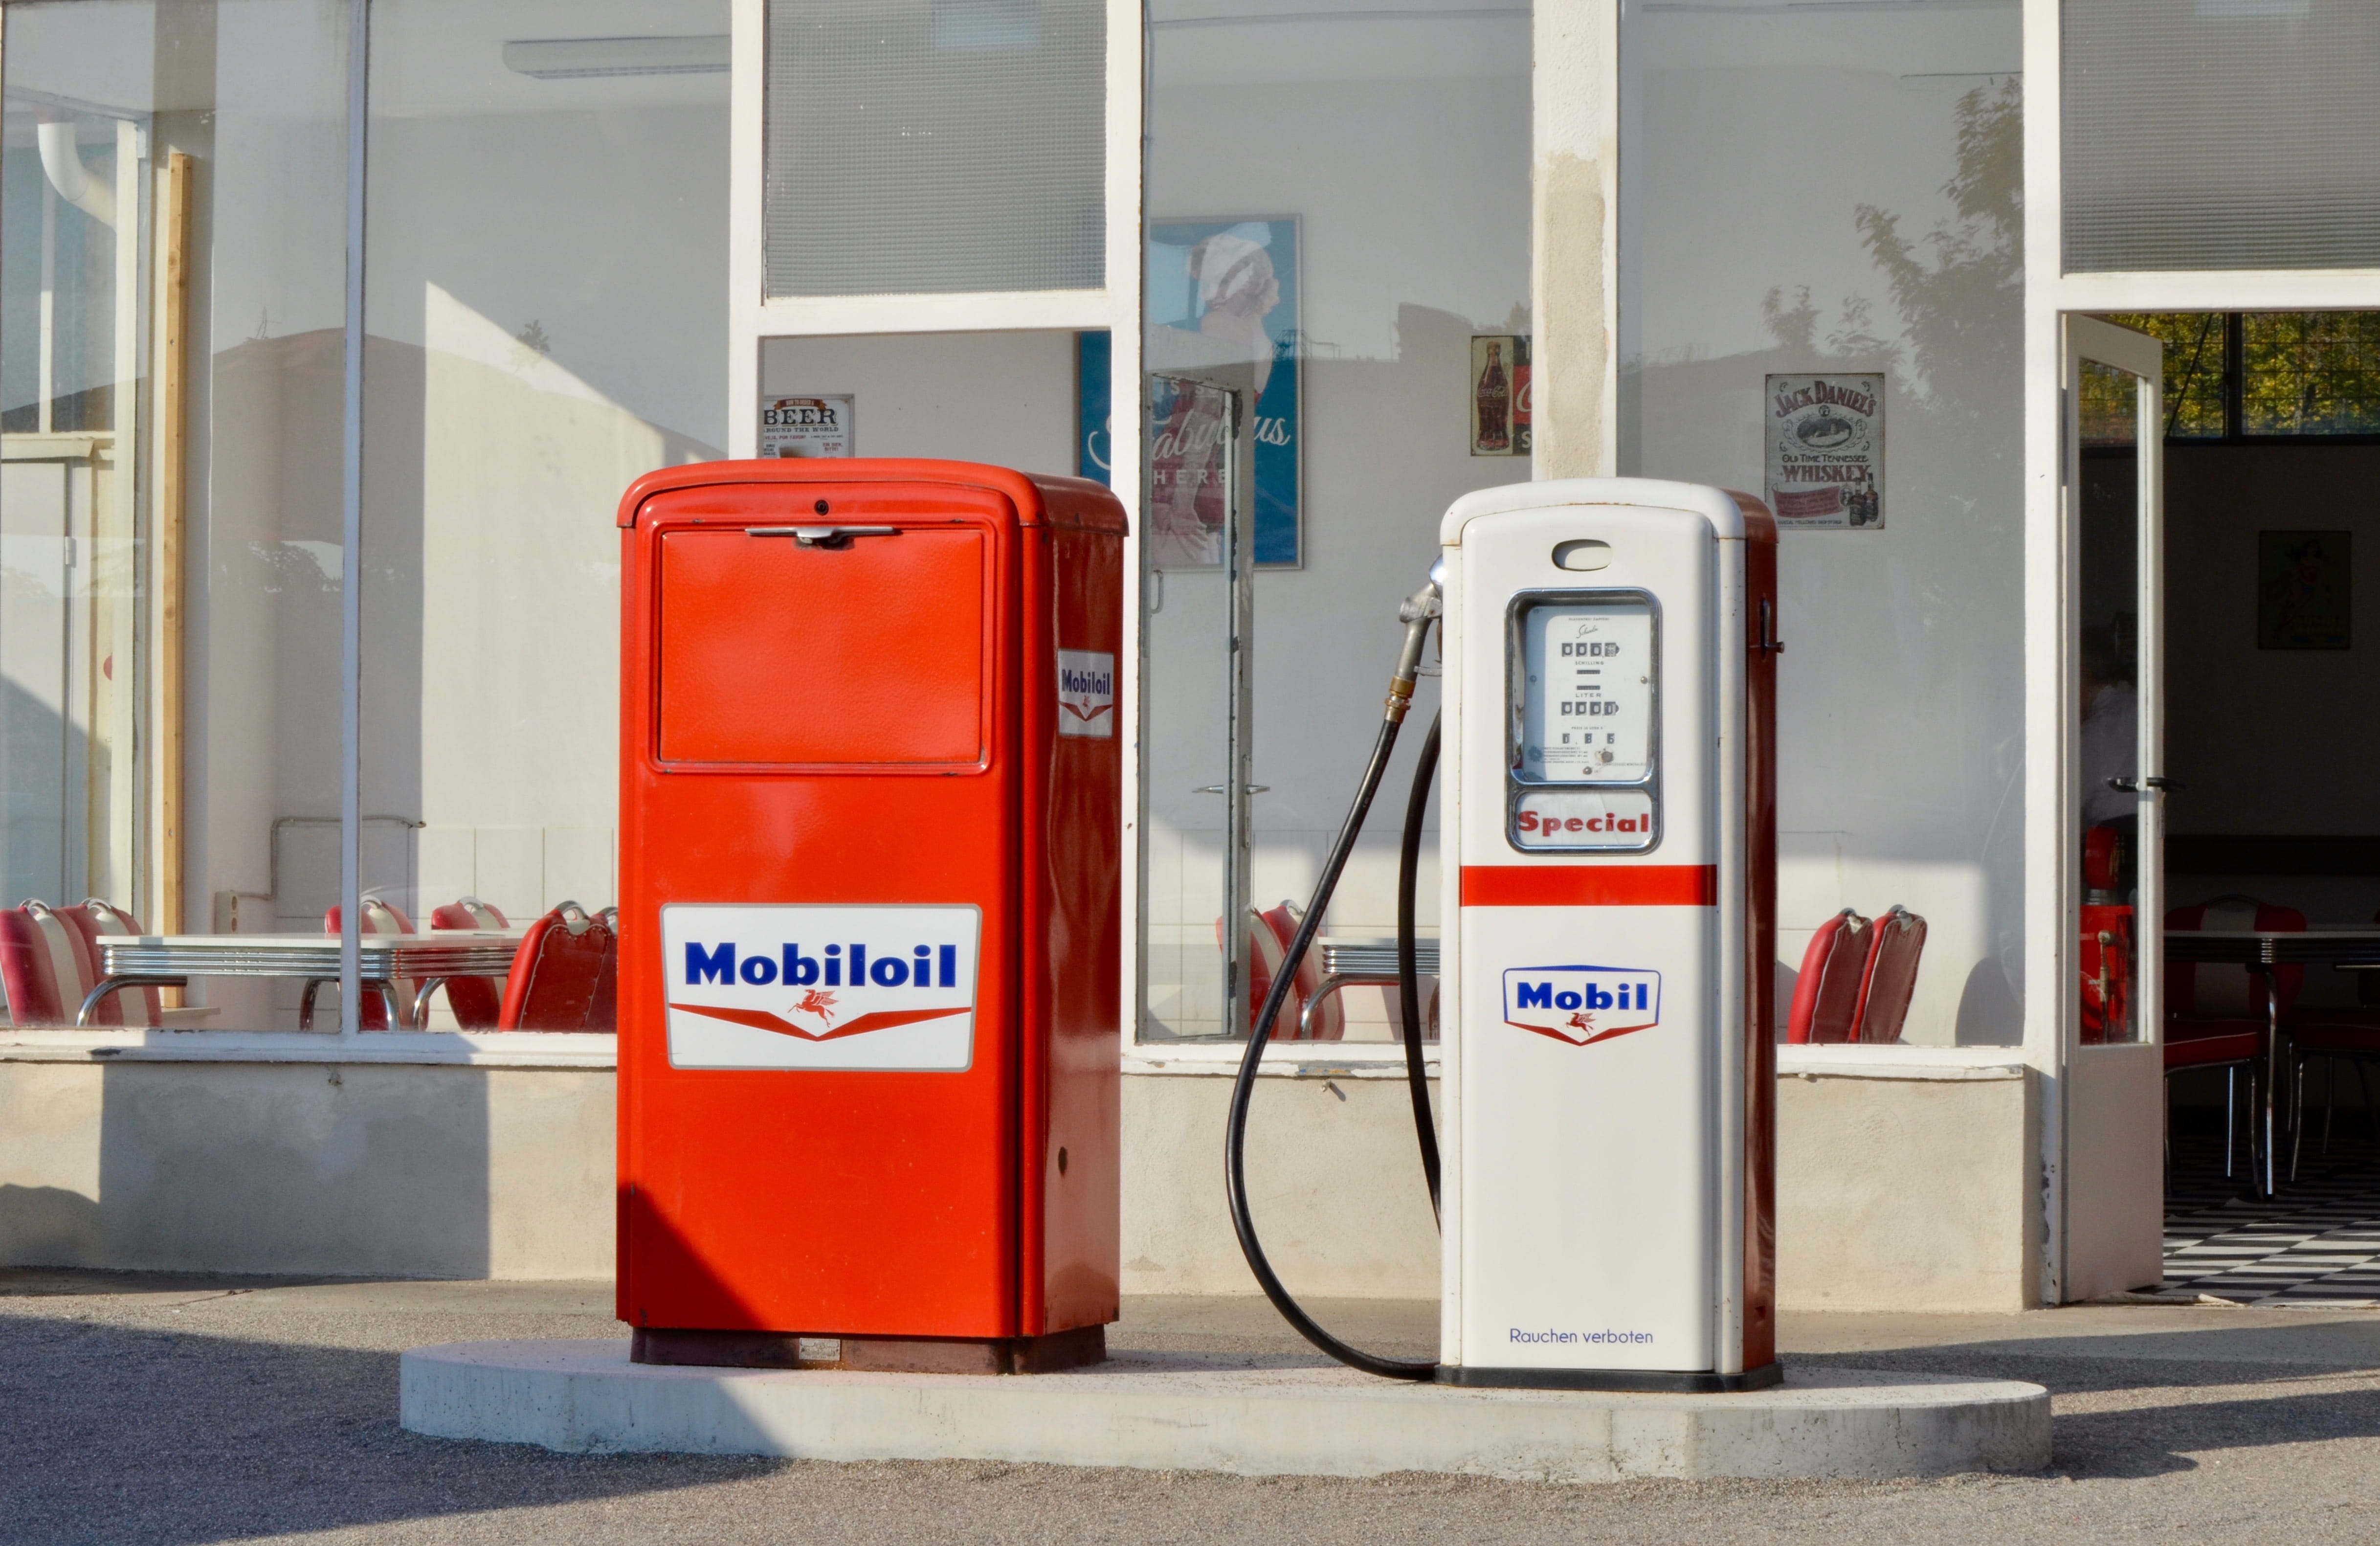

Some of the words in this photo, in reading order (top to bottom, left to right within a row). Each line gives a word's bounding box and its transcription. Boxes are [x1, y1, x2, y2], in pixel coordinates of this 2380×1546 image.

[1774, 386, 1814, 418] JACK
[764, 409, 837, 425] BEER
[1800, 454, 1820, 463] TIME
[1823, 454, 1868, 463] TENNESSEE
[1781, 465, 1871, 482] WHISKEY
[1062, 669, 1110, 695] Mobiloil
[1518, 810, 1649, 837] Special
[685, 942, 956, 987] Mobiloil
[1517, 982, 1648, 1010] Mobil
[1510, 1328, 1578, 1343] Rauchen
[1582, 1328, 1653, 1344] verboten
